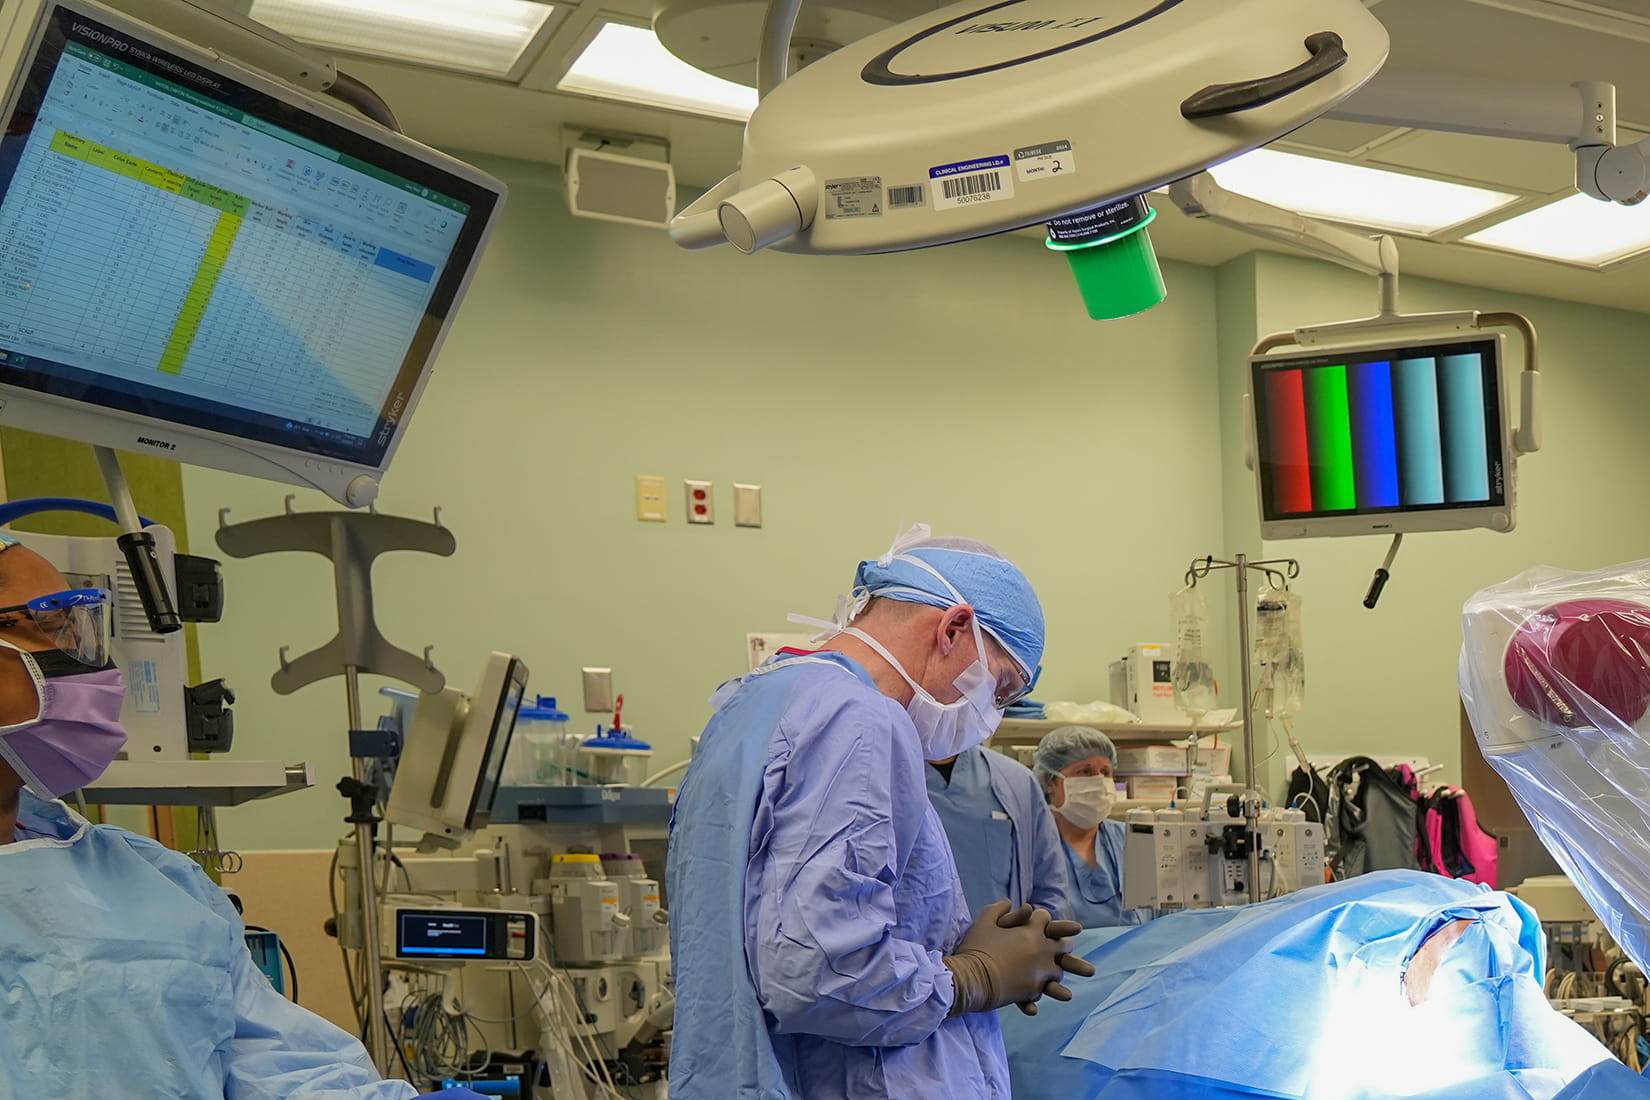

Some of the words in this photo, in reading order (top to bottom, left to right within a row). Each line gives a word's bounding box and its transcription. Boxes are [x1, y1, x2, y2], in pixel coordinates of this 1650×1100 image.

[71, 22, 129, 52] VISIONPRO
[151, 55, 184, 74] WIRELESS
[183, 69, 198, 79] LED
[197, 73, 222, 89] DISPLAY
[935, 165, 957, 176] CLINICAL
[957, 161, 992, 173] ENGINEERING
[1052, 160, 1062, 173] 2
[957, 192, 991, 205] 50076238
[1062, 217, 1072, 226] not
[1072, 213, 1097, 225] remove
[1097, 210, 1105, 219] or
[377, 390, 405, 448] stryker
[137, 435, 170, 450] MONITOR
[169, 443, 177, 451] 2
[1495, 460, 1503, 495] stryker
